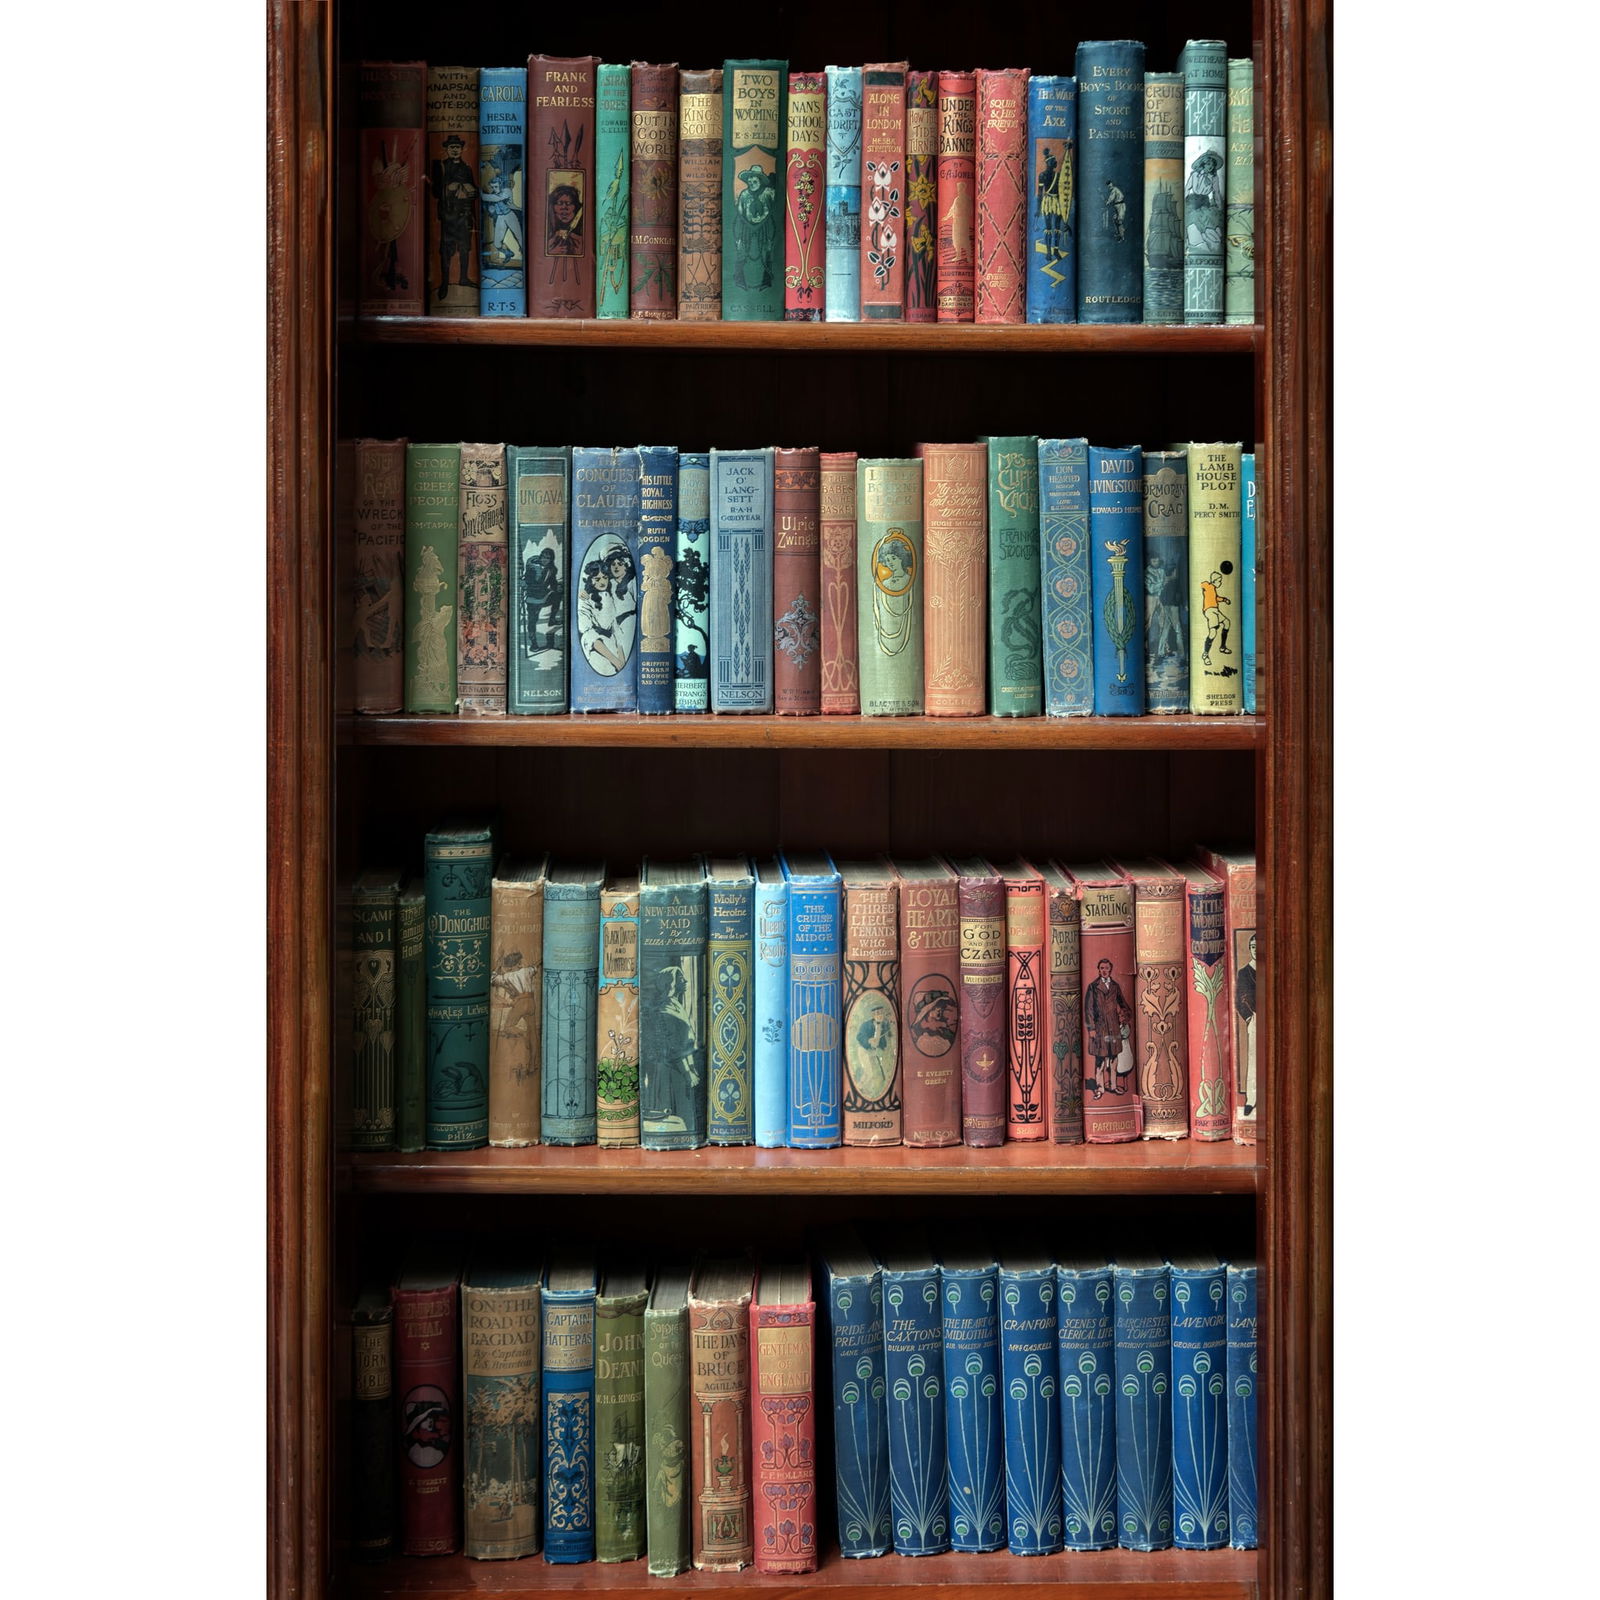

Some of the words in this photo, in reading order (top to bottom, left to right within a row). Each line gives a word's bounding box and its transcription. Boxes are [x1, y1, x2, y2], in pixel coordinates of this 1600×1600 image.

[546, 71, 588, 82] FRANK
[1092, 67, 1131, 77] EVERY
[740, 74, 773, 86] TWO
[553, 84, 578, 93] AND
[738, 87, 775, 99] BOYS
[1080, 82, 1111, 93] BOY'S
[480, 86, 525, 102] CAROLA
[868, 93, 900, 104] ALONE
[1037, 88, 1054, 100] THE
[536, 96, 595, 107] FEARLESS
[690, 96, 712, 106] THE
[750, 100, 761, 108] IN
[941, 98, 974, 112] UNDER
[989, 99, 1016, 109] SQUIB
[1145, 99, 1162, 110] OF
[792, 101, 820, 113] NAN'S
[828, 108, 857, 117] CAST
[878, 105, 890, 117] IN
[1094, 105, 1131, 115] SPORT
[487, 113, 517, 121] HESBA
[735, 108, 779, 121] WYOMING
[990, 111, 1001, 119] &
[1146, 111, 1171, 123] THE
[634, 114, 659, 127] OUT
[787, 115, 825, 129] SCHOOL
[827, 120, 859, 130] ADRIFT
[866, 119, 902, 130] LONDON
[1042, 115, 1066, 127] AXE
[481, 125, 522, 135] STRETTON
[1088, 129, 1137, 141] PASTIME
[791, 130, 820, 142] DAYS
[939, 136, 974, 154] BANNER
[1086, 295, 1142, 304] ROUTLEDGE
[414, 458, 456, 469] STORY
[1207, 454, 1227, 463] THE
[726, 467, 755, 477] JACK
[1055, 465, 1073, 474] LION
[1101, 459, 1135, 474] DAVID
[1200, 463, 1235, 472] LAMB
[641, 475, 653, 485] HIS
[653, 475, 673, 485] LITTLE
[1196, 472, 1237, 482] HOUSE
[414, 481, 457, 492] GREEK
[601, 484, 616, 492] OF
[1201, 481, 1236, 491] PLOT
[641, 487, 665, 497] ROYAL
[520, 490, 568, 506] UNGAVA
[575, 494, 639, 508] CLAUDIA
[727, 494, 753, 503] SETT
[641, 499, 673, 510] HIGHNESS
[820, 505, 855, 514] BASKET
[1149, 499, 1183, 519] CRAG
[1194, 511, 1218, 519] PERCY
[782, 516, 815, 531] Ulric
[523, 689, 562, 698] NELSON
[721, 690, 763, 699] NELSON
[672, 895, 680, 905] A
[713, 894, 746, 906] Molly's
[858, 892, 888, 904] THE
[908, 889, 956, 907] LOYAL
[1096, 894, 1115, 902] THE
[713, 906, 747, 917] Heroine
[804, 904, 825, 914] THE
[851, 903, 896, 915] THREE
[1085, 902, 1128, 917] STARLING
[1192, 899, 1225, 913] LITTLE
[660, 918, 691, 929] MAID
[796, 914, 833, 924] CRUISE
[906, 910, 958, 928] HEARTS
[669, 929, 682, 937] By
[798, 924, 812, 933] OF
[812, 923, 832, 933] THE
[850, 926, 896, 937] TENANTS
[357, 931, 384, 944] AND
[795, 933, 833, 943] MIDGE
[963, 928, 1001, 941] GOD
[908, 932, 922, 950] &
[851, 948, 894, 961] Kingston
[712, 1126, 747, 1134] NELSON
[852, 1121, 894, 1131] MILFORD
[1091, 1118, 1137, 1132] PARTRIDGE
[470, 1299, 495, 1313] ON
[503, 1299, 537, 1312] THE
[470, 1314, 513, 1329] ROAD
[518, 1314, 536, 1328] TO
[546, 1312, 592, 1327] CAPTAIN
[892, 1319, 916, 1331] THE
[944, 1318, 961, 1329] THE
[962, 1317, 986, 1329] HEART
[1003, 1317, 1057, 1331] CRANFORD
[1065, 1318, 1096, 1330] SCENES
[781, 1330, 789, 1340] A
[834, 1323, 865, 1336] PRIDE
[887, 1328, 942, 1342] CAXTONS
[1058, 1329, 1095, 1341] CLERICAL
[1097, 1326, 1114, 1338] LIFE
[1126, 1326, 1168, 1339] TOWERS
[470, 1330, 536, 1346] BAGDAD
[543, 1330, 593, 1348] HATTERAS
[599, 1332, 645, 1353] JOHN
[694, 1334, 719, 1349] THE
[887, 1344, 915, 1352] BULWER
[1023, 1341, 1053, 1351] GASKELL
[1172, 1341, 1201, 1349] GEORGE
[713, 1351, 730, 1361] OF
[697, 1360, 745, 1377] BRUCE
[777, 1358, 793, 1370] OF
[759, 1371, 811, 1387] ENGLAND
